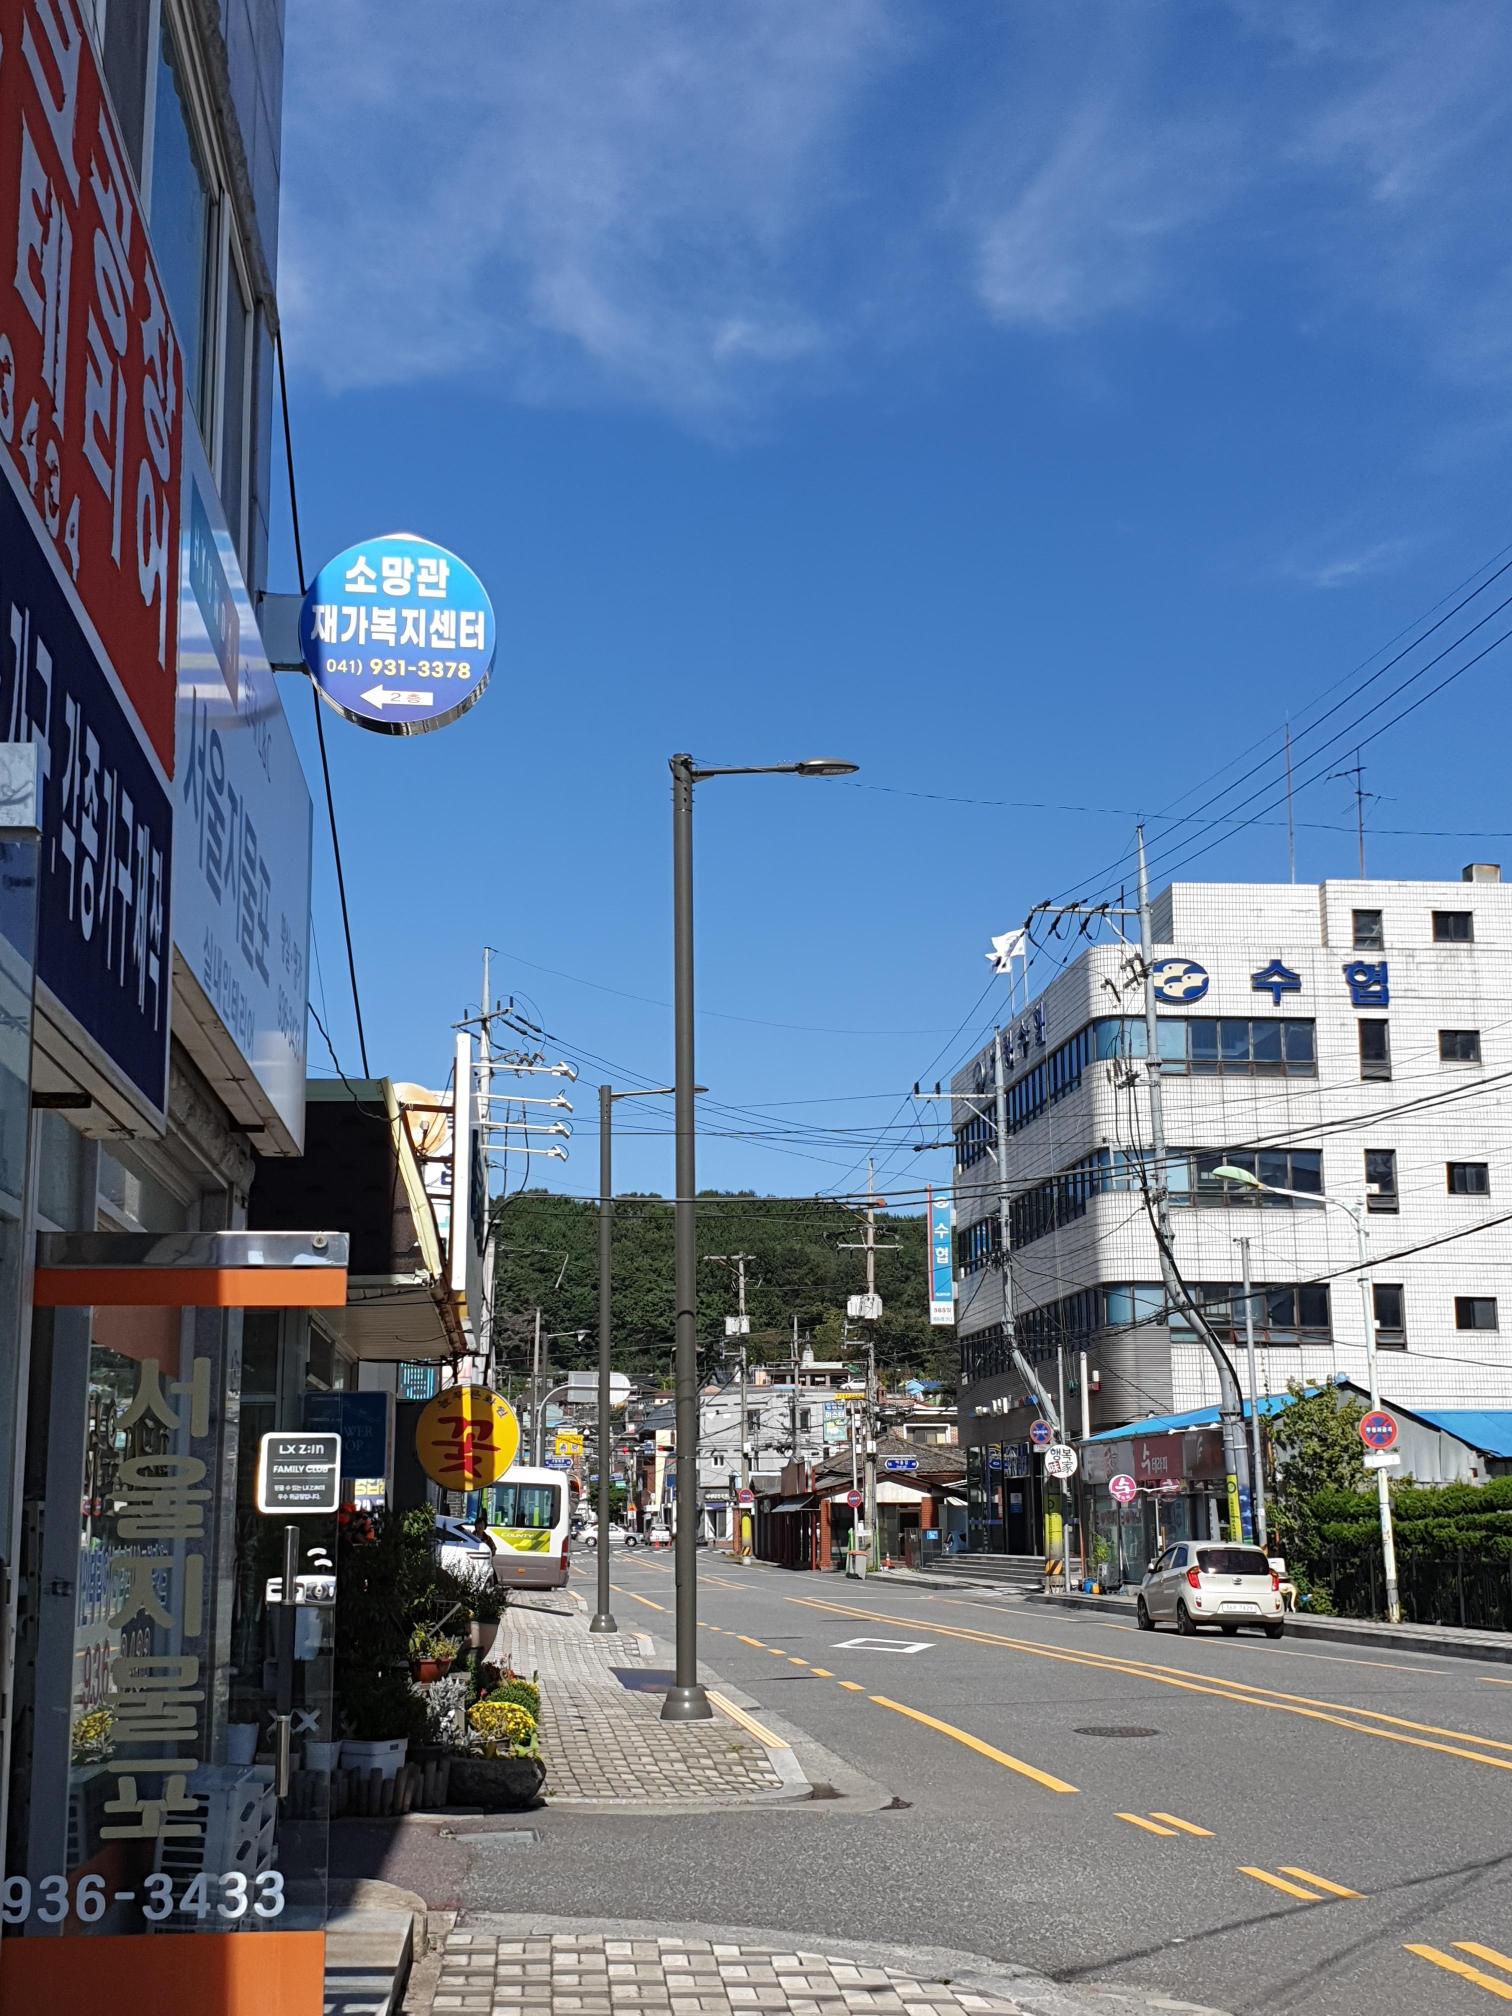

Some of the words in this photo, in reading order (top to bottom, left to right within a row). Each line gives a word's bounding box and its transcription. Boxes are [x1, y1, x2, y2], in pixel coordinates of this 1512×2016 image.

[0, 33, 170, 673] 테리어
[344, 555, 450, 598] 소망관
[311, 604, 485, 650] 재가복지센터
[326, 658, 363, 675] 041)
[370, 658, 471, 679] 931-3378
[184, 685, 272, 989] 서울지물포
[1251, 959, 1389, 1008] 수협
[273, 1465, 305, 1473] FAMILY
[279, 1445, 296, 1454] LX
[431, 1416, 501, 1478] 꽃
[99, 1356, 212, 1840] 서울지물포
[2, 1870, 285, 1924] 936-3433
